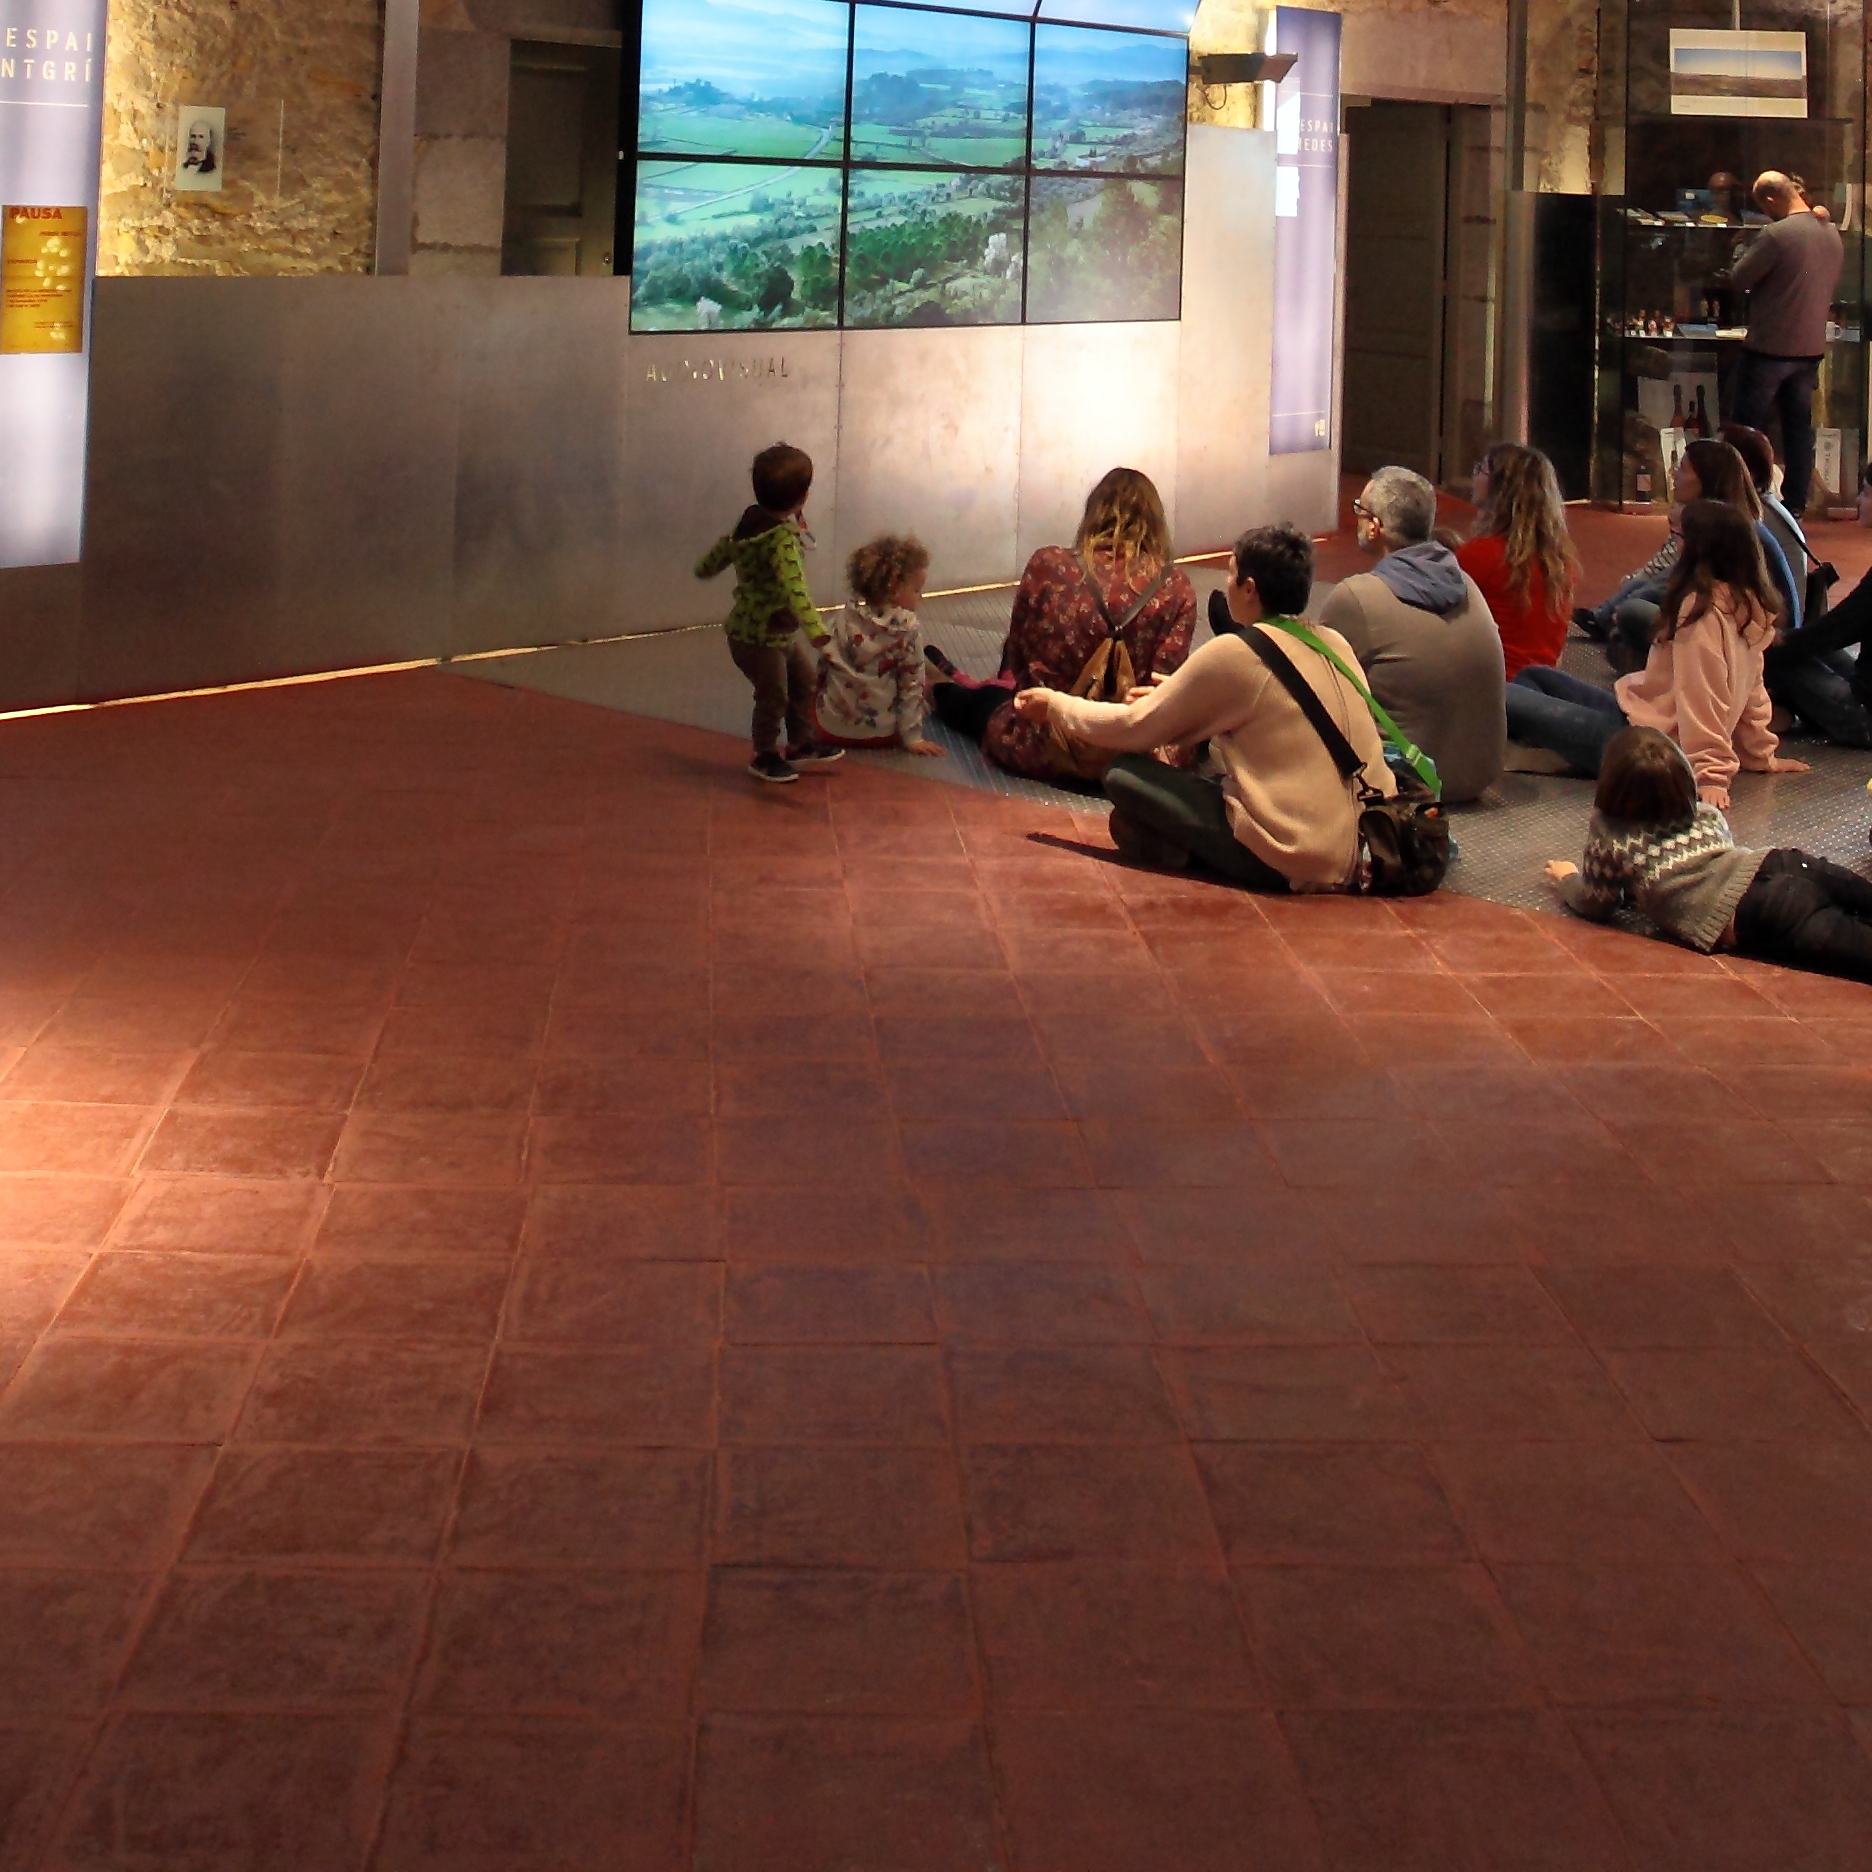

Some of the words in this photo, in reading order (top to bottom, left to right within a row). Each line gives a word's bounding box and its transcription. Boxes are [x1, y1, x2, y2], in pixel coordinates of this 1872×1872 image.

[6, 27, 92, 52] ESPAI
[1300, 119, 1334, 133] ESPAI
[8, 207, 63, 219] PAUSA
